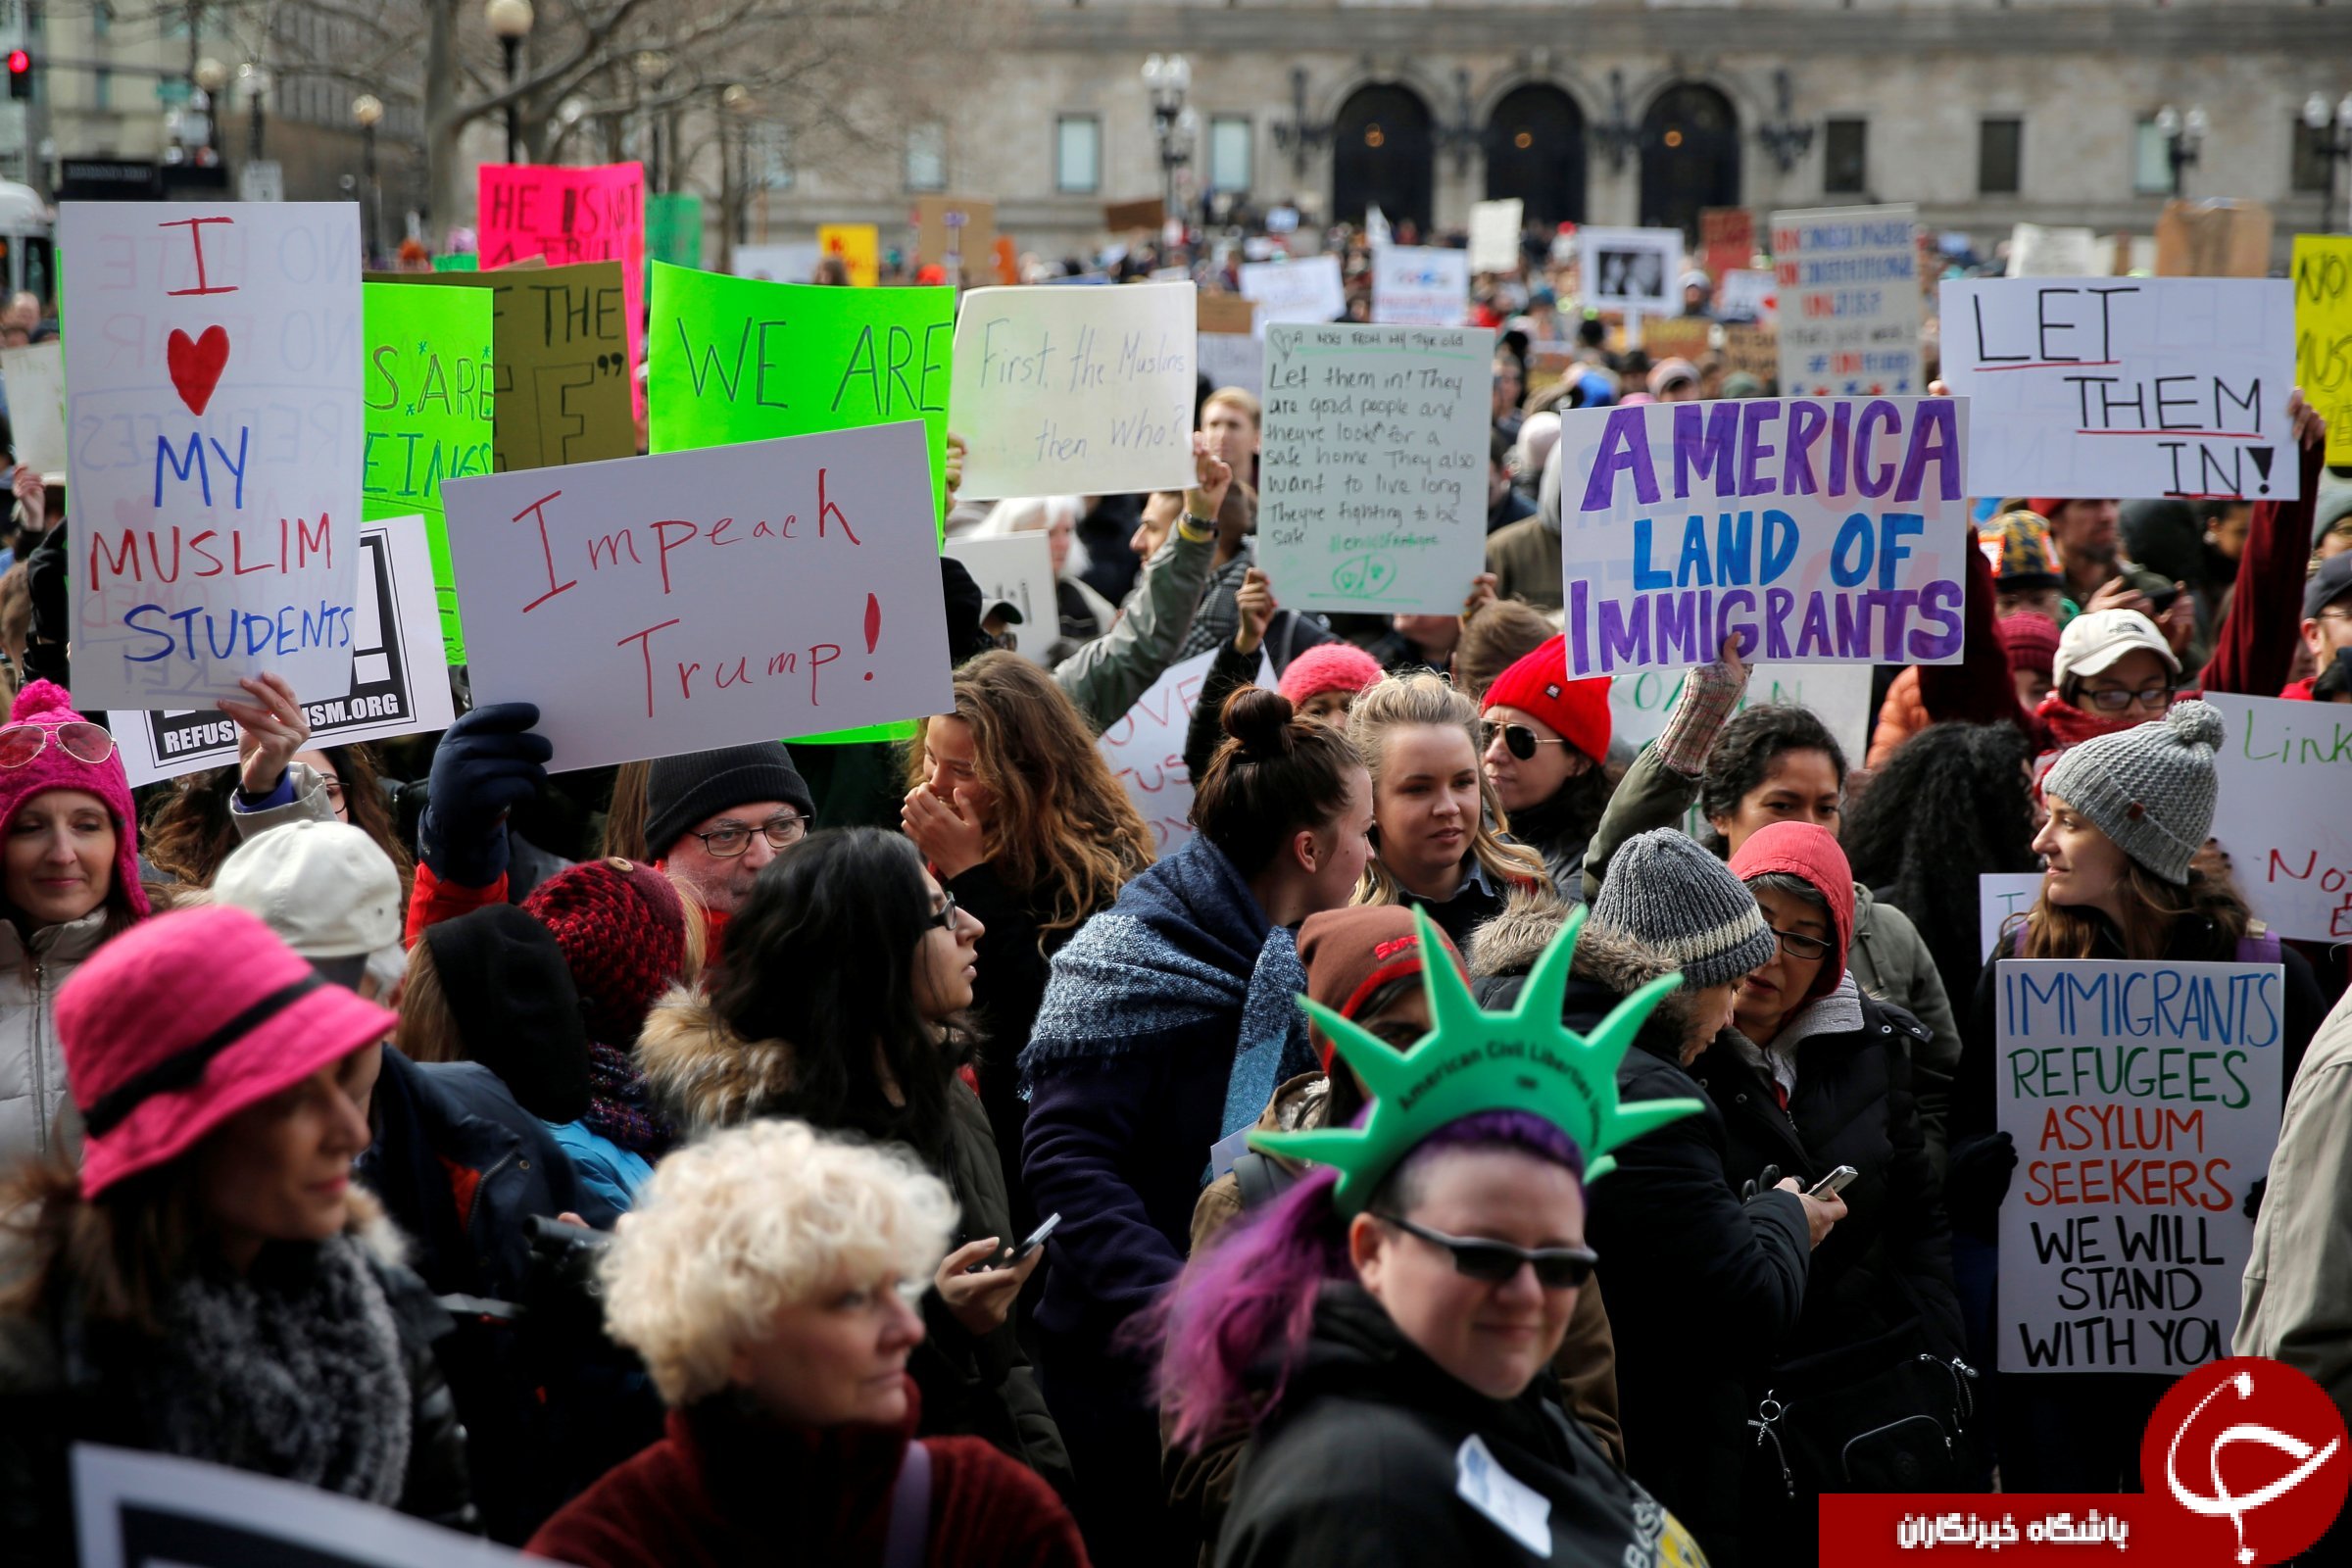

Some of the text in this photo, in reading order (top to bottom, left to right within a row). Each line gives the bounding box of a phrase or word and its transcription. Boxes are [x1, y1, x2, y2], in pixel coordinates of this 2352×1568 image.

[492, 183, 541, 232] HE
[158, 217, 239, 295] I
[527, 285, 622, 348] THE
[1974, 287, 2140, 364] LET
[417, 354, 493, 421] ARE
[676, 317, 953, 416] WE ARE
[1069, 323, 1104, 392] the
[1269, 363, 1309, 390] Let
[1324, 366, 1376, 389] them
[1418, 368, 1463, 399] They
[1035, 404, 1185, 462] then Who?
[1268, 399, 1298, 415] are
[1308, 394, 1352, 421] good
[1360, 397, 1409, 417] people
[2063, 375, 2261, 433] THEM
[154, 425, 249, 510] MY
[1315, 446, 1369, 466] home
[1383, 450, 1432, 474] They
[1438, 450, 1476, 470] also
[1426, 429, 1441, 446] a
[1580, 399, 1962, 512] AMERICA
[1344, 473, 1364, 493] to
[1376, 473, 1411, 494] live
[1421, 475, 1461, 506] long
[2157, 442, 2275, 496] IN!
[512, 468, 860, 613] Impeach
[1412, 504, 1429, 521] to
[90, 512, 332, 591] MUSLIM
[1633, 509, 1924, 590] LAND OF
[123, 600, 354, 662] STUDENTS
[617, 592, 882, 718] Trump!
[1570, 579, 1963, 675] IMMIGRANTS
[2006, 969, 2278, 1048] IMMIGRANTS
[1397, 1048, 1483, 1113] American
[1486, 1040, 1525, 1059] Civil
[2007, 1045, 2251, 1109] REFUGEES
[2038, 1103, 2204, 1153] ASYLUM
[2024, 1157, 2234, 1211] SEEKERS
[2030, 1213, 2225, 1265] WE WILL
[2057, 1266, 2202, 1311] STAND
[2018, 1316, 2137, 1367] WITH
